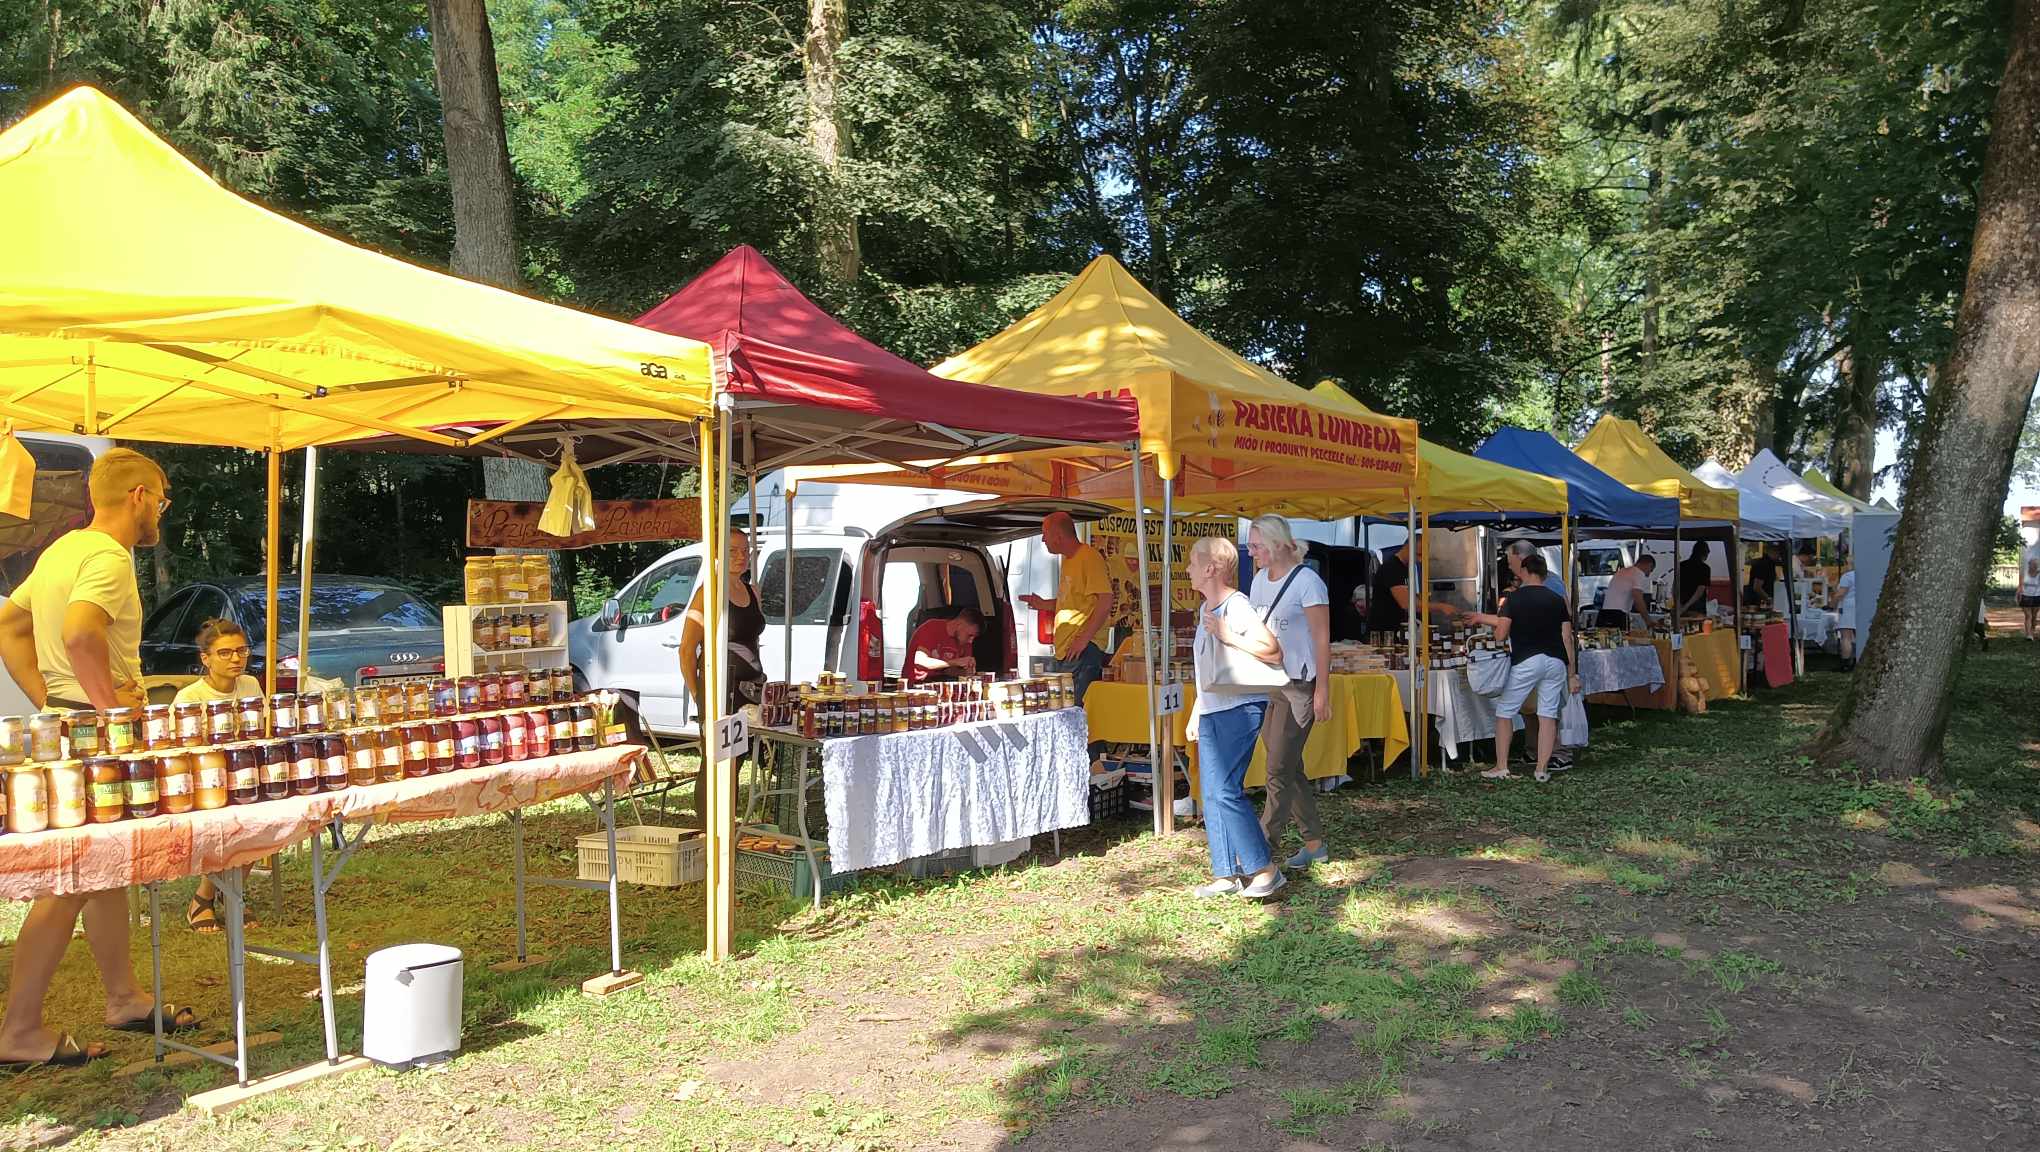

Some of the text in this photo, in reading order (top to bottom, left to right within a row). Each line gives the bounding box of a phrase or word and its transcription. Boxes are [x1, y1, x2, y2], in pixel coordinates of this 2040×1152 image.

[1232, 400, 1313, 437] PASIEKA
[1234, 434, 1258, 450] MIÓD
[1265, 440, 1308, 458] PRODUKTY
[601, 506, 672, 537] Pasieka
[1180, 521, 1236, 538] PASIECZNE
[1164, 692, 1180, 710] 11
[721, 720, 744, 749] 12
